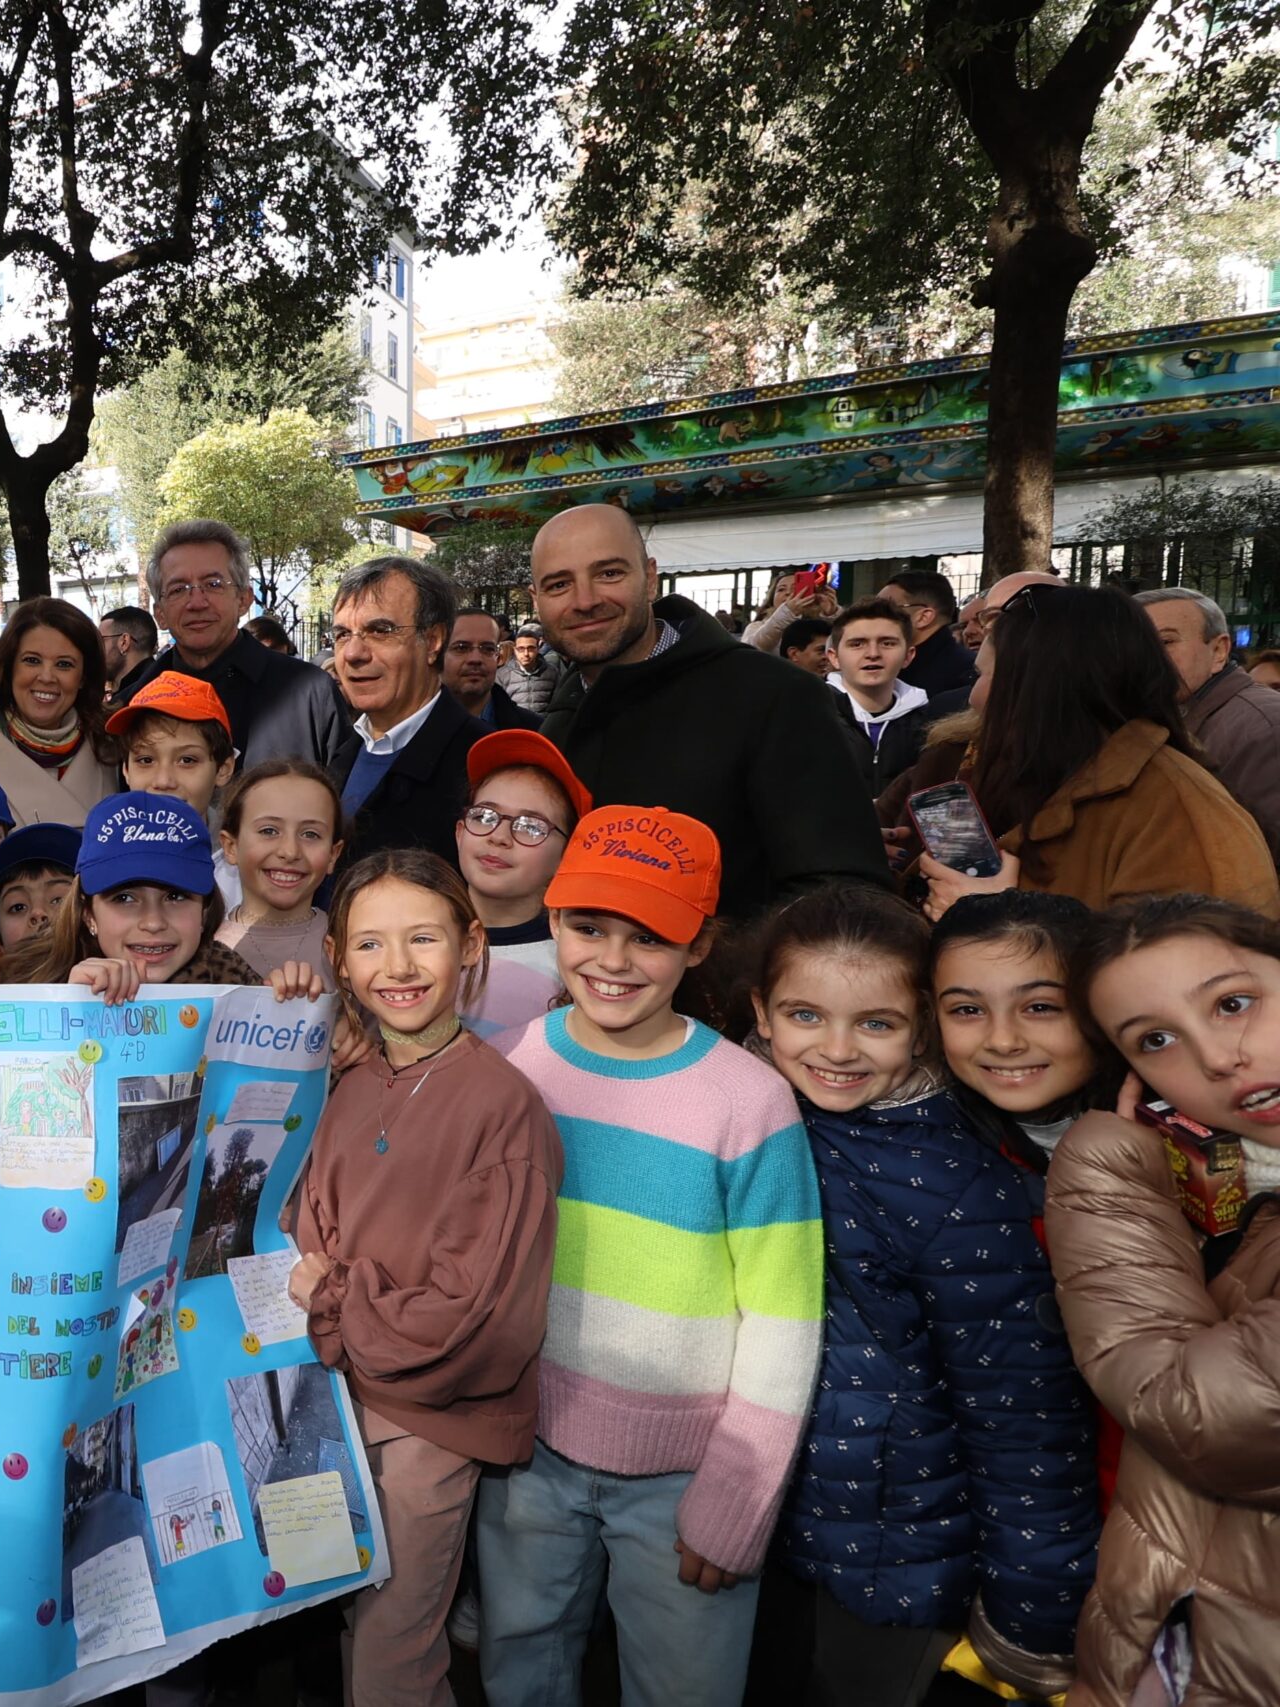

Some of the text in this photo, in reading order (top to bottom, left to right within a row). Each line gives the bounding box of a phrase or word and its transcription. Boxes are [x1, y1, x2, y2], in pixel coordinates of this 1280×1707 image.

[122, 824, 166, 843] Elena
[599, 838, 673, 871] Viviana
[215, 1013, 306, 1052] unicef
[7, 1315, 41, 1337] DEL
